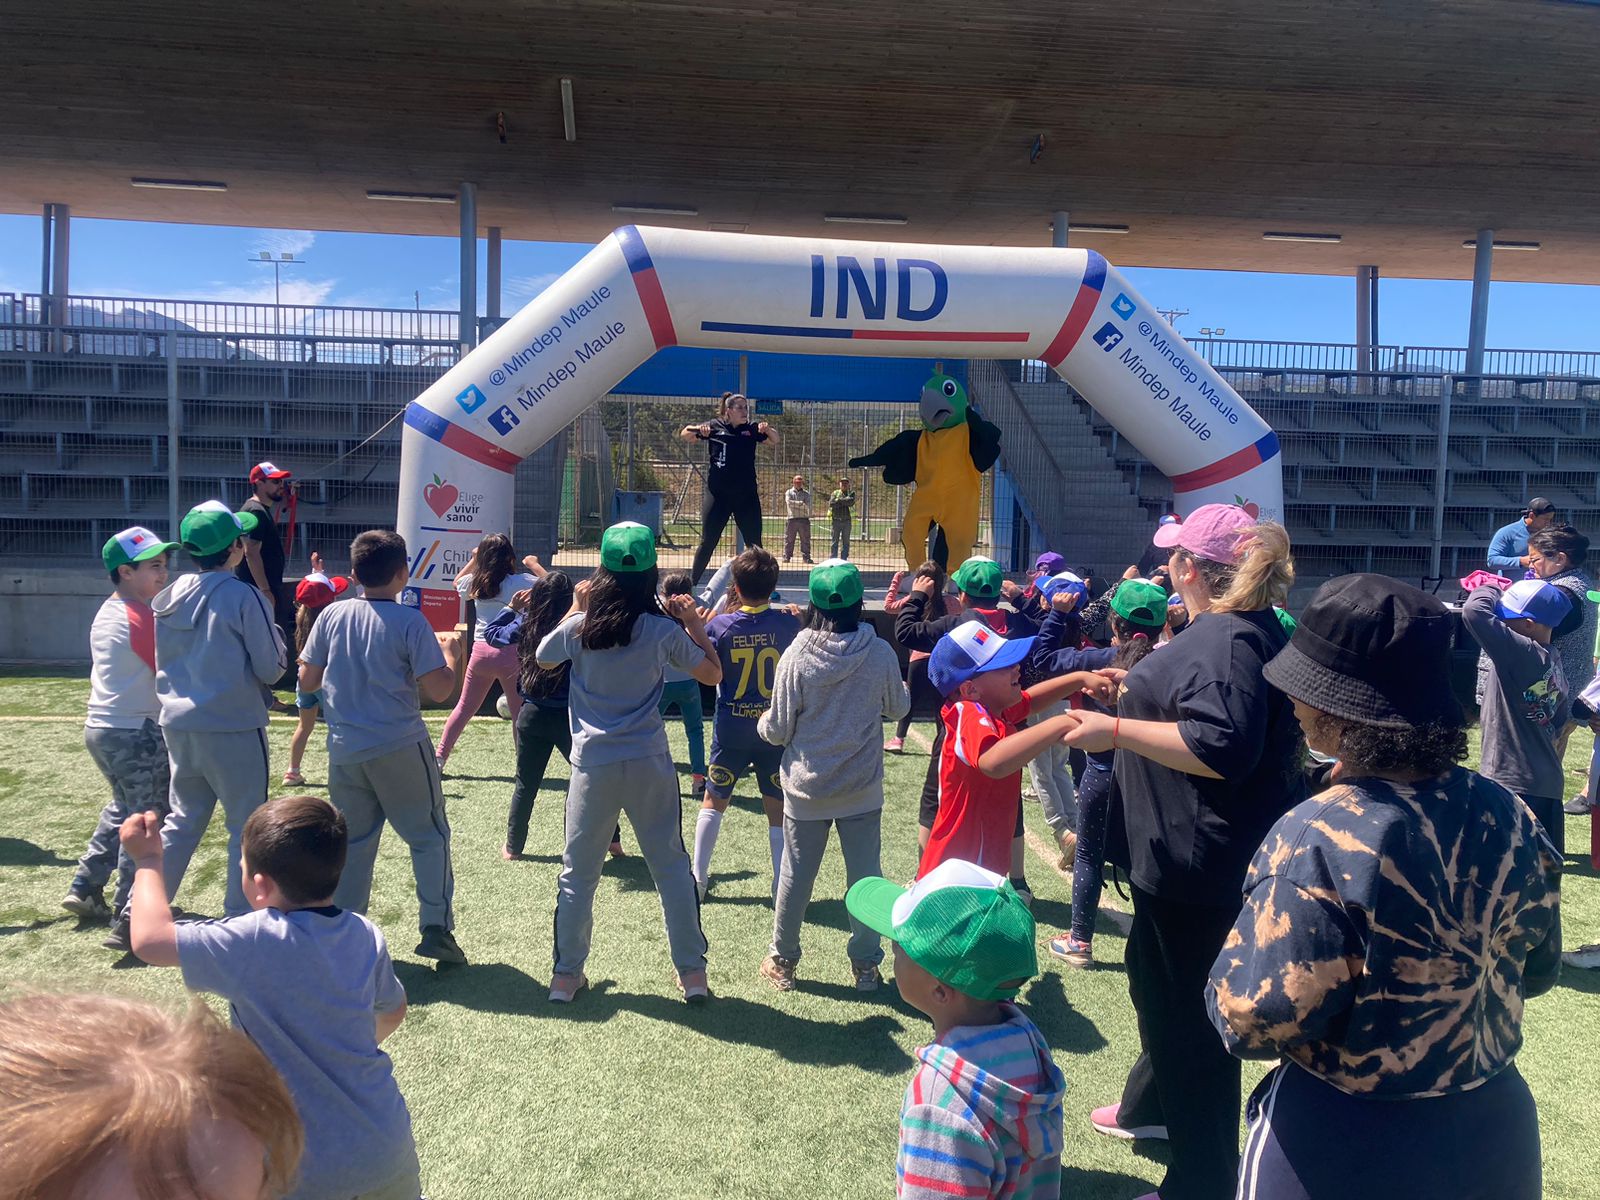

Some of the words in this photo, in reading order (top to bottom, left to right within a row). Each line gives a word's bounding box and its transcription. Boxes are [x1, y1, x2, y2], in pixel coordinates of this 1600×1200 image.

[810, 254, 948, 321] IND
[489, 326, 562, 386] @Mindep
[560, 286, 611, 328] Maule
[517, 361, 577, 411] Mindep
[574, 322, 626, 363] Maule
[1138, 321, 1198, 384] @Mindep
[1198, 381, 1239, 425] Maule
[1119, 347, 1170, 401] Mindep
[1168, 396, 1212, 441] Maule
[446, 513, 473, 523] sano
[454, 503, 480, 514] vivir
[459, 491, 484, 505] Elige
[443, 549, 473, 562] Chil
[733, 634, 768, 648] FELIPE
[730, 647, 781, 700] 70
